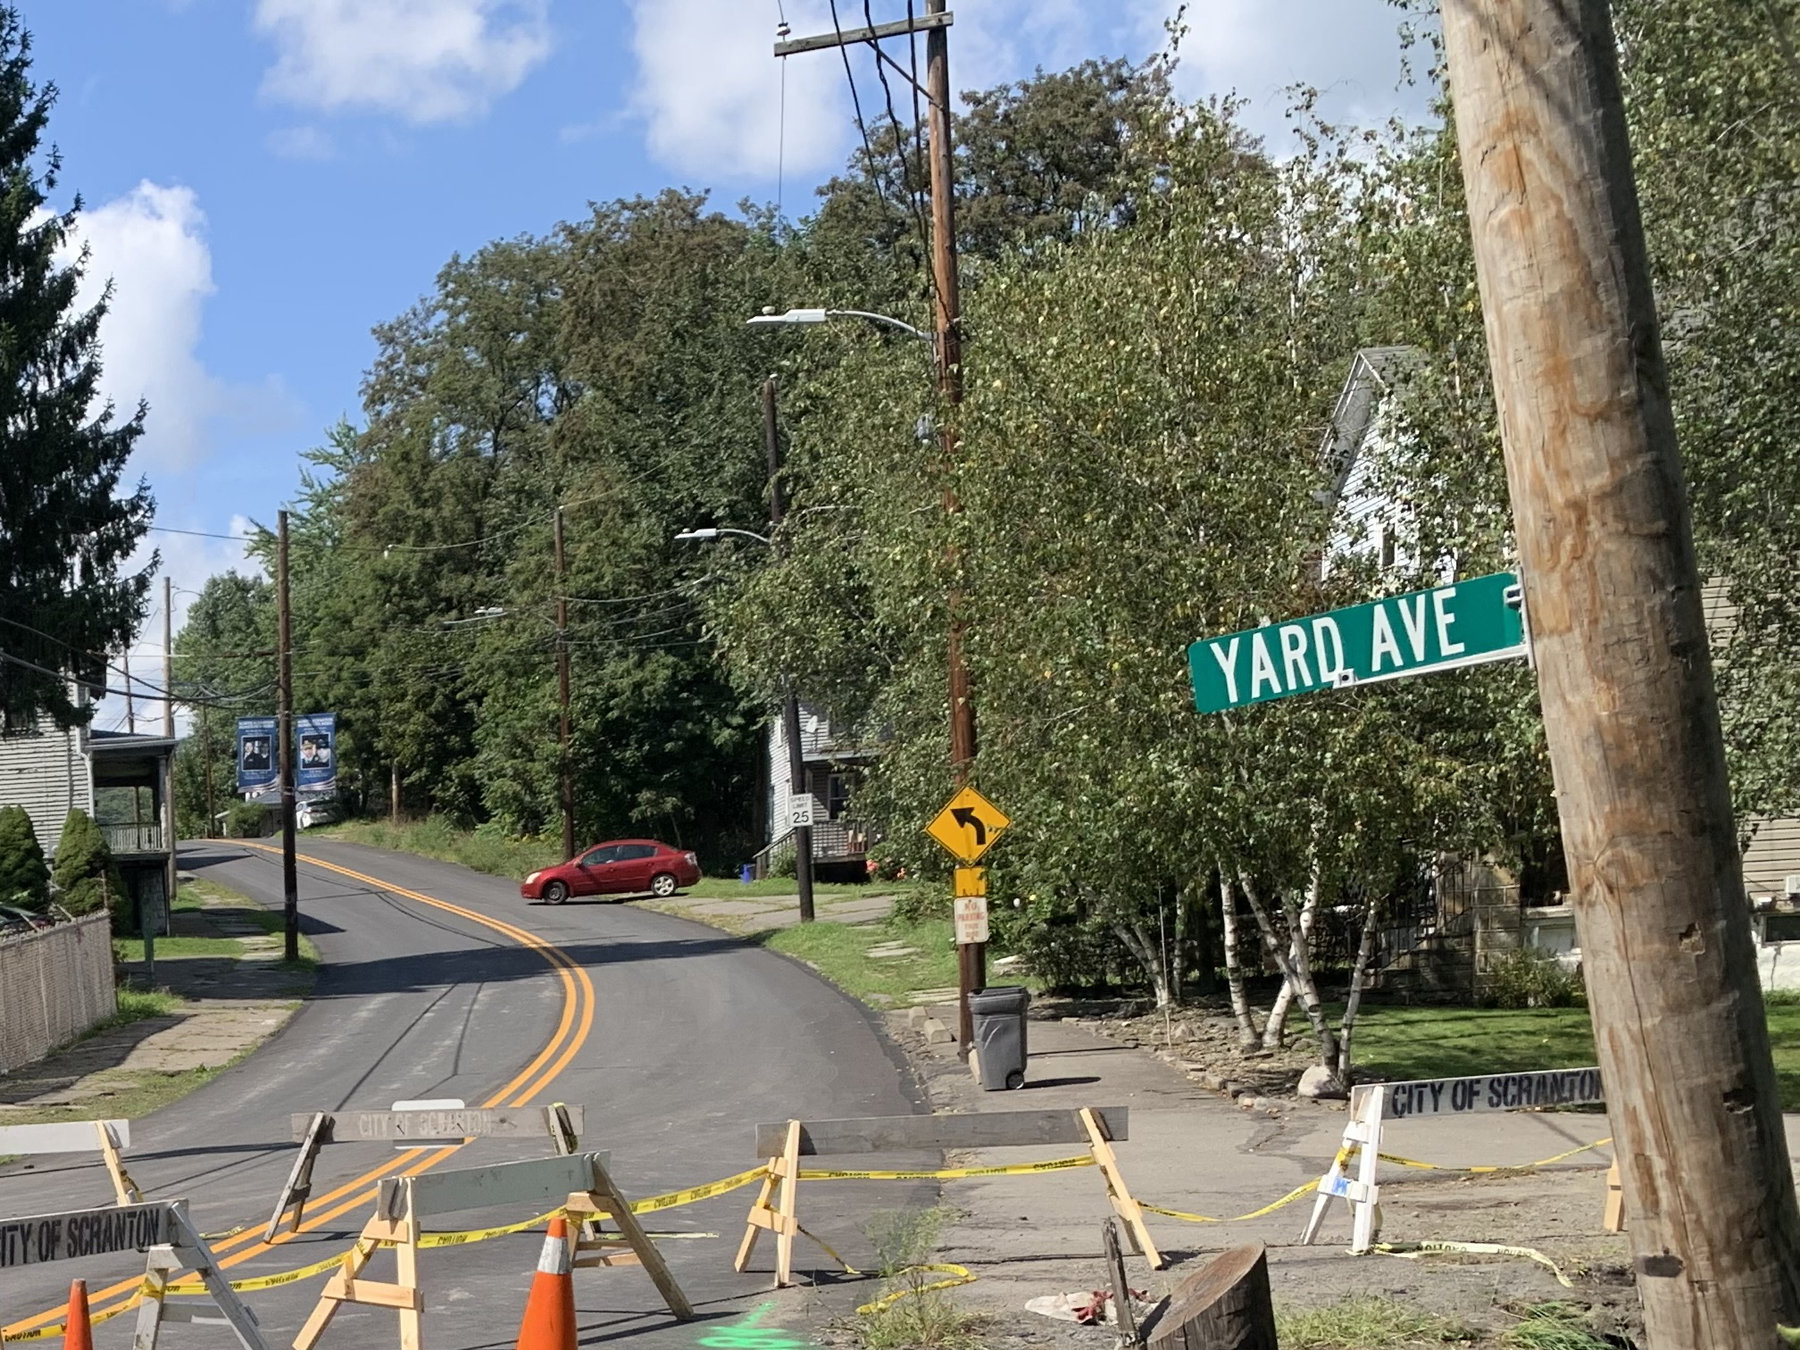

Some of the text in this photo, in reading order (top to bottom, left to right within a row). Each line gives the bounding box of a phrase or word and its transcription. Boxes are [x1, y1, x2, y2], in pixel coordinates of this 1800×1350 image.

[1210, 586, 1465, 703] YARD AVE
[792, 811, 810, 824] 25
[1392, 1082, 1444, 1118] CITY
[1452, 1079, 1481, 1112] OF
[38, 1220, 62, 1262] OF
[67, 1208, 160, 1259] SCRANTON
